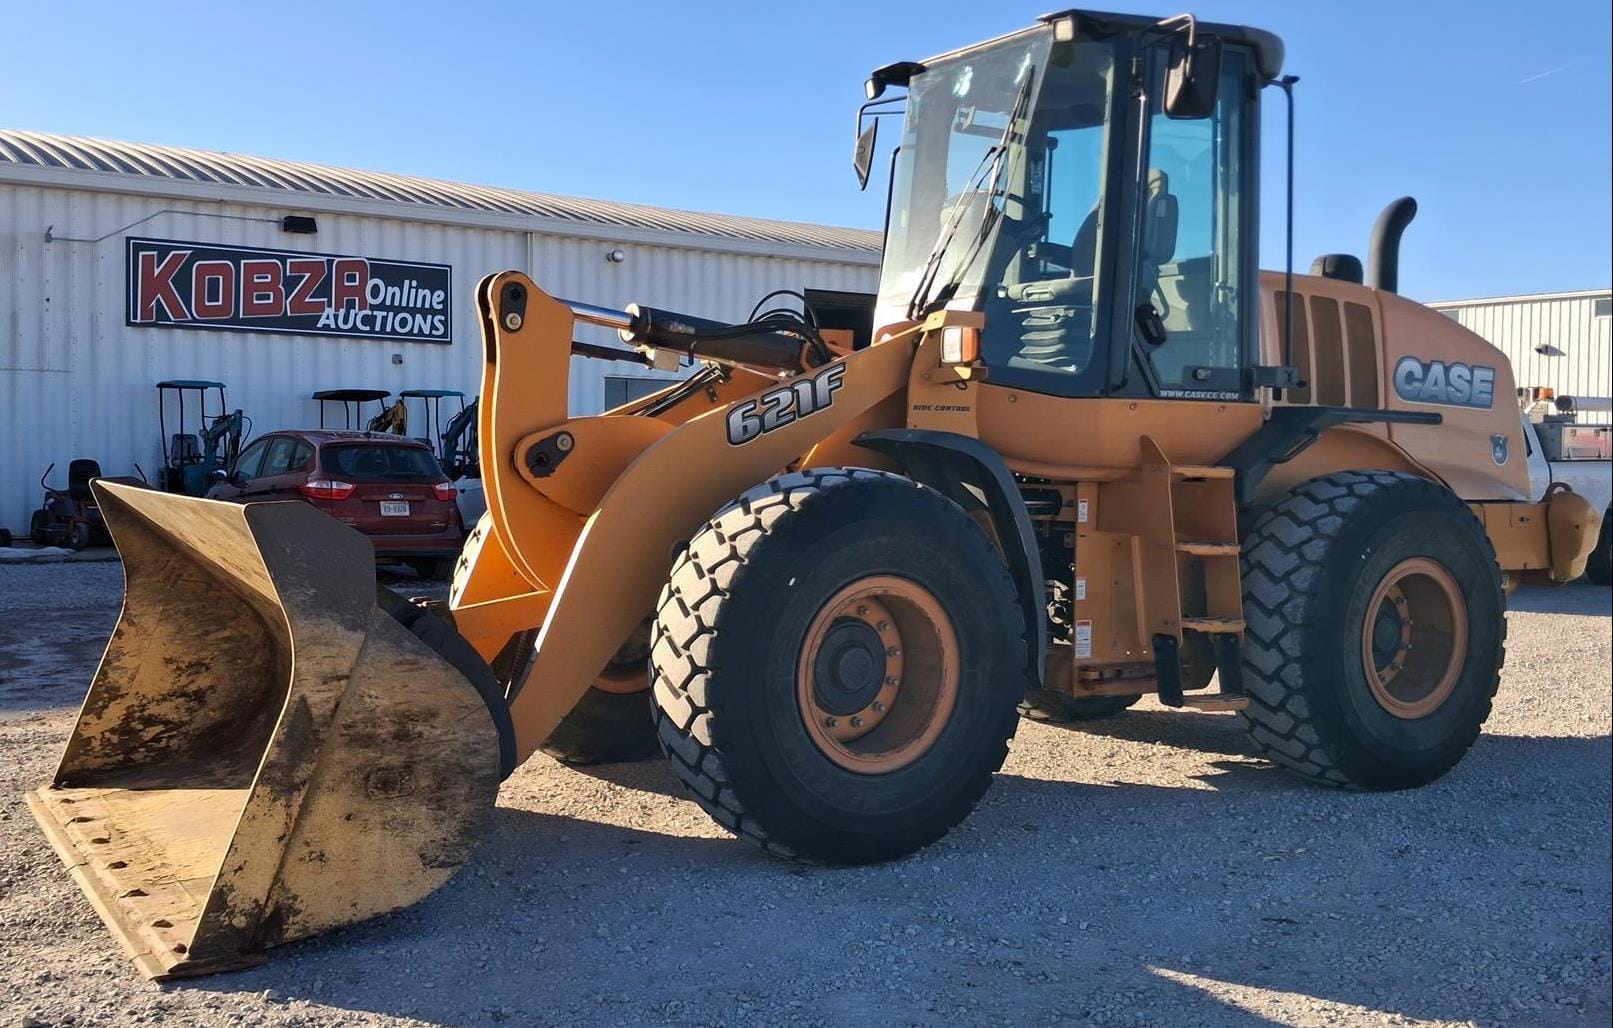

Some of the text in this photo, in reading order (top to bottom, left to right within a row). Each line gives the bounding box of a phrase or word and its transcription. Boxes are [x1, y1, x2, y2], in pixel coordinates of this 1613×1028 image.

[137, 250, 370, 323] KOBZA
[365, 278, 445, 309] Online
[317, 307, 445, 336] AUCTIONS
[726, 361, 846, 445] 621F
[1394, 357, 1494, 408] CASE
[934, 404, 970, 412] CONTROL
